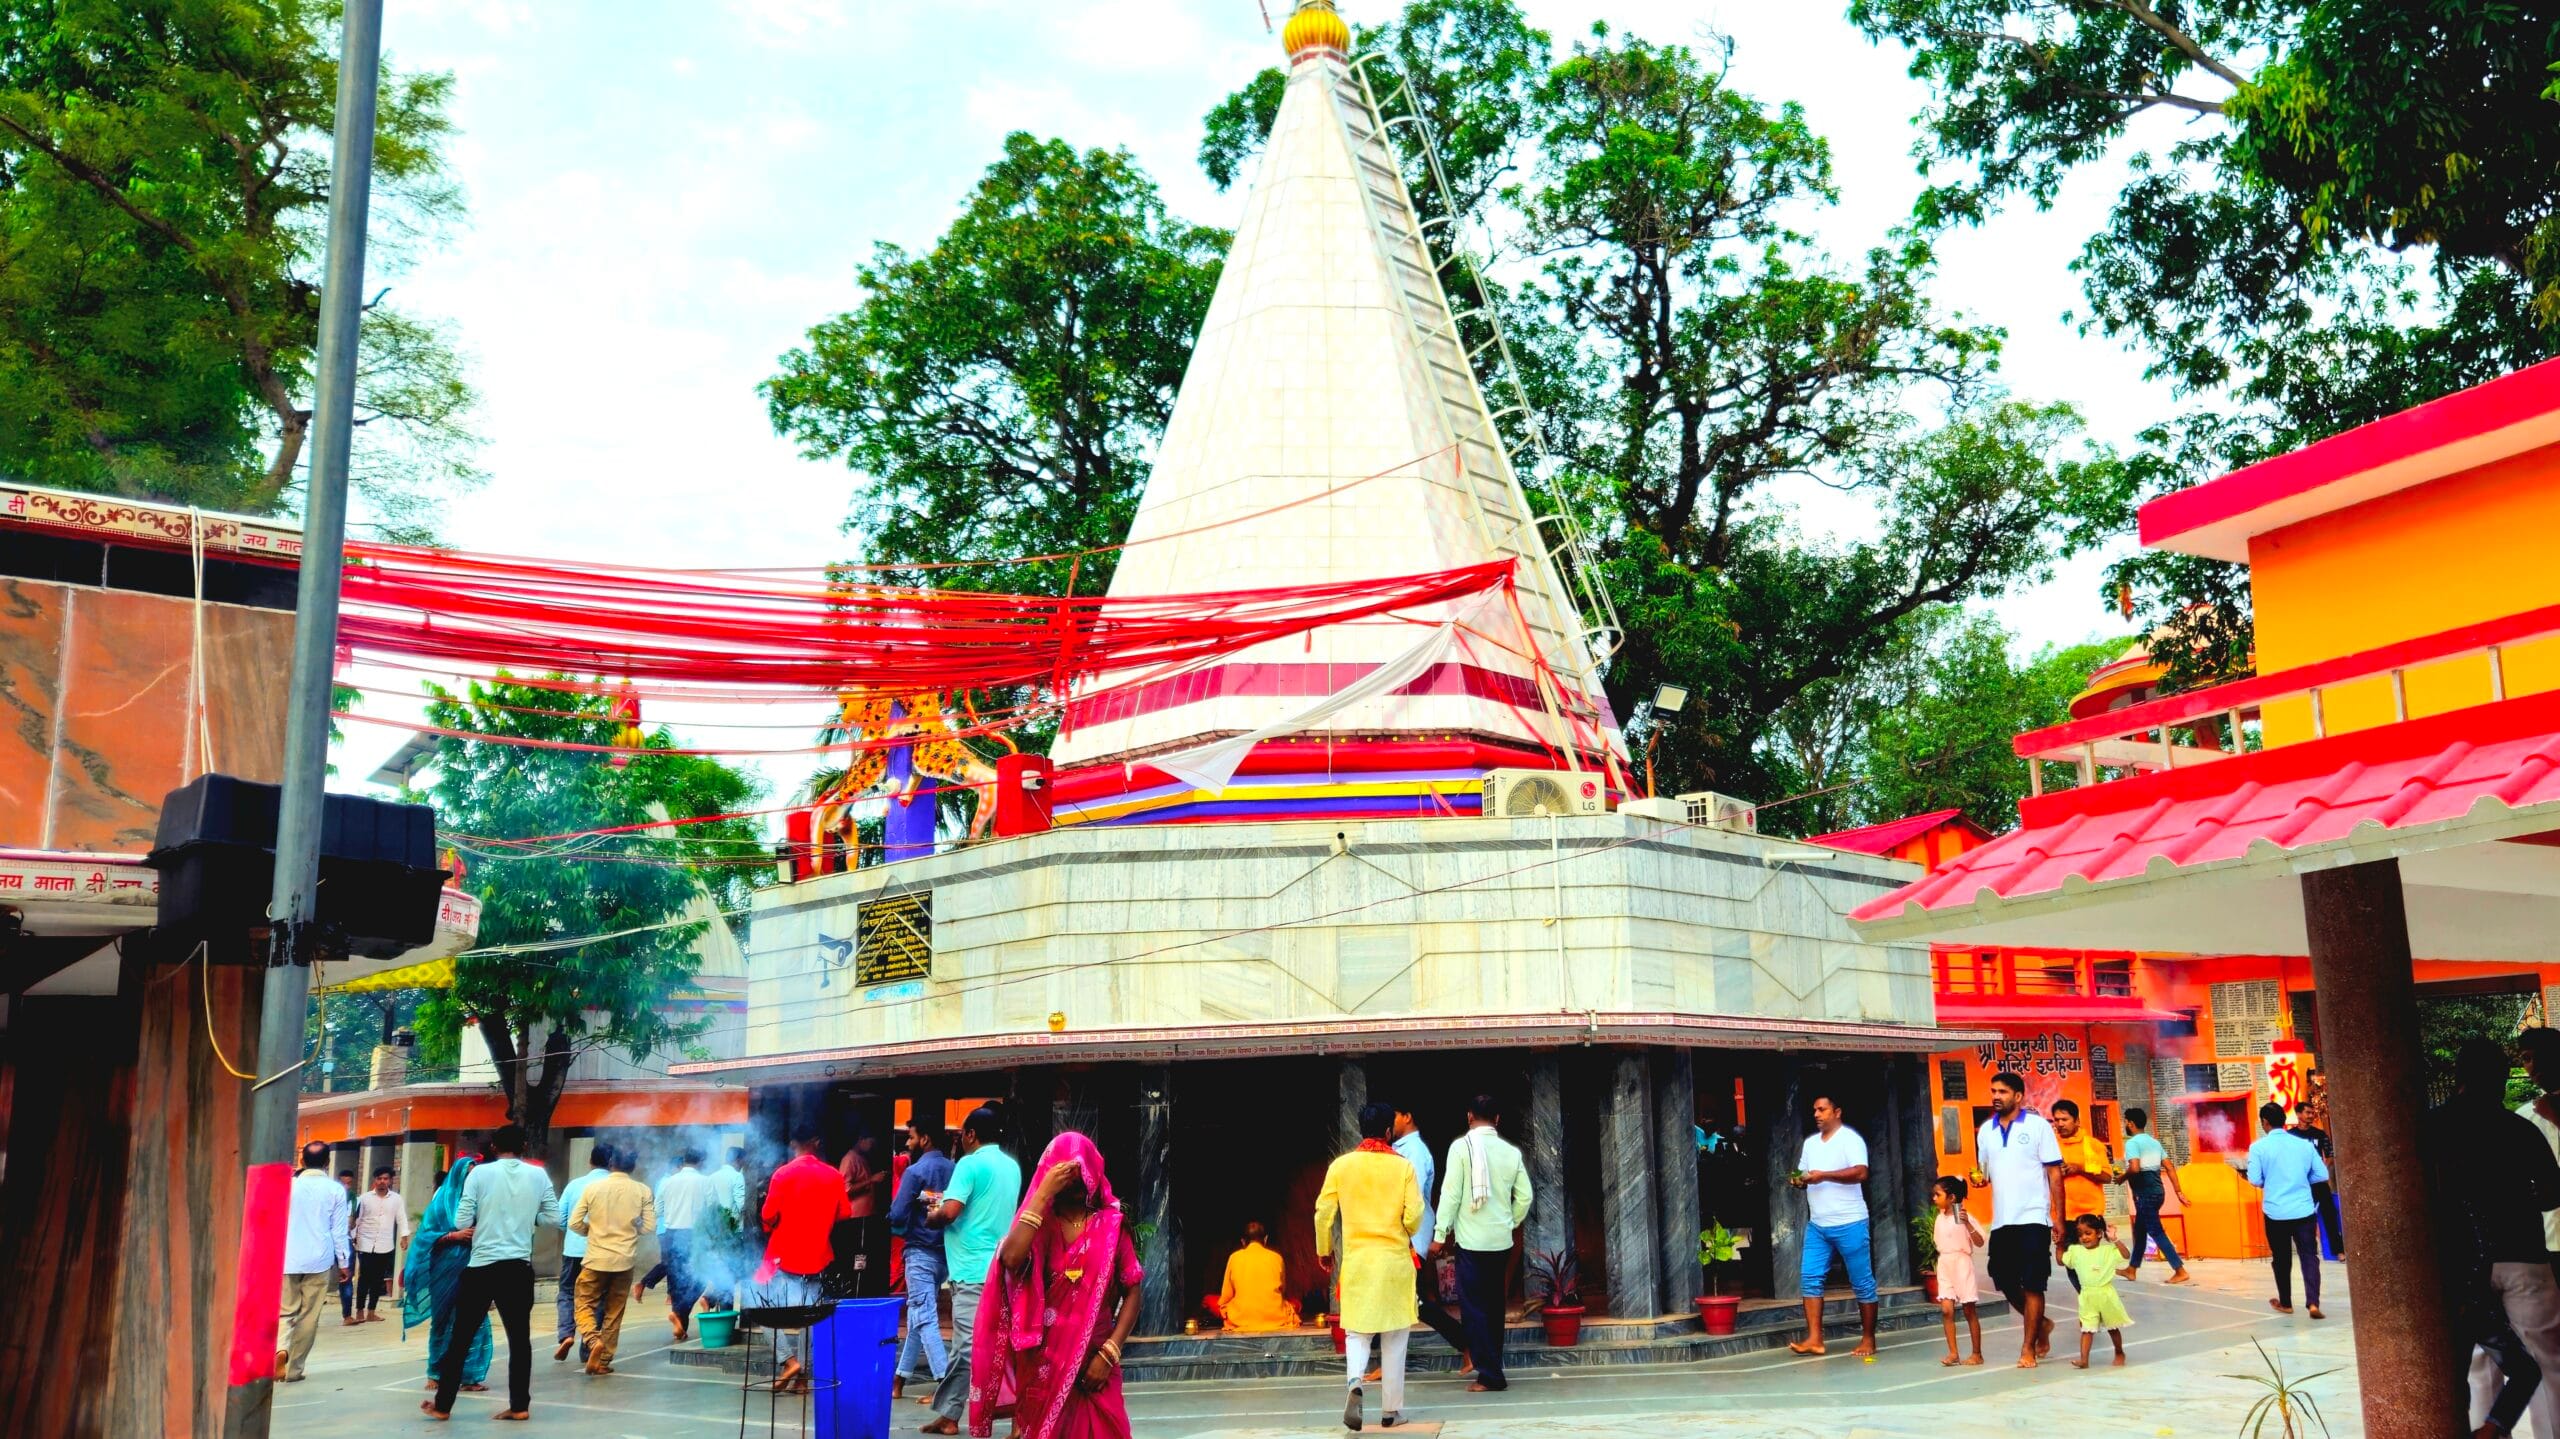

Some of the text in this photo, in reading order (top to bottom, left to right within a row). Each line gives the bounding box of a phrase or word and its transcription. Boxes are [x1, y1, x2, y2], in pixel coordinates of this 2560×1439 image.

[8, 495, 25, 514] दी
[242, 533, 304, 553] जय मात
[1582, 801, 1596, 811] LG
[34, 876, 75, 891] माता
[86, 872, 106, 894] दी
[442, 903, 451, 921] दी
[2000, 1032, 2049, 1056] पंचमुखी
[2052, 1032, 2080, 1054] शिव
[2035, 1054, 2084, 1079] इटहिया
